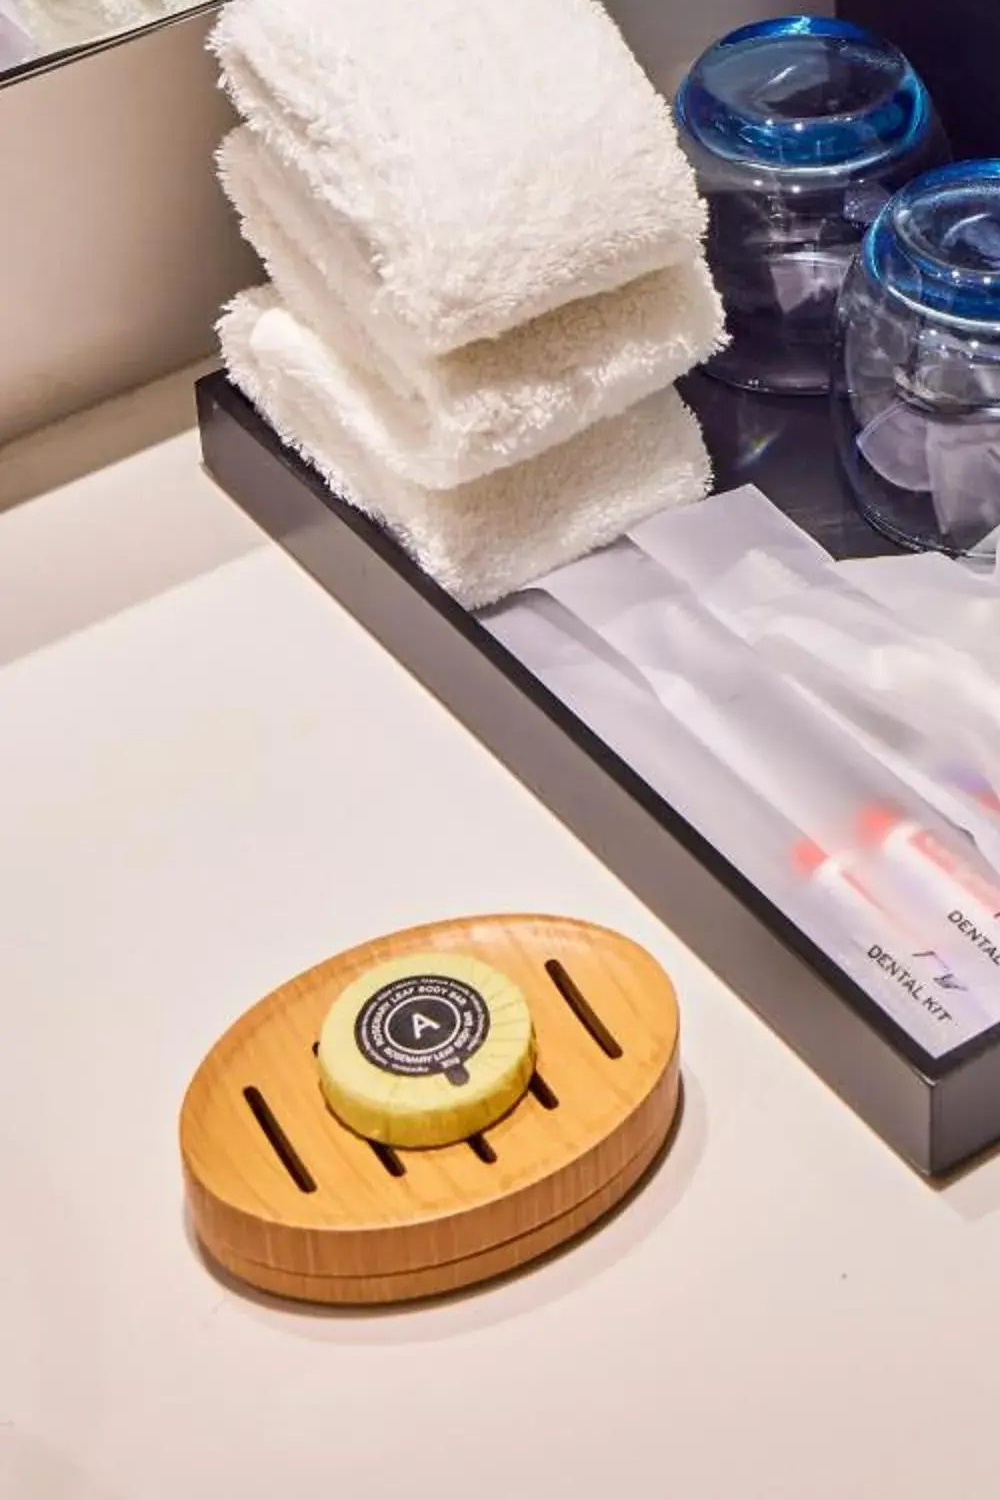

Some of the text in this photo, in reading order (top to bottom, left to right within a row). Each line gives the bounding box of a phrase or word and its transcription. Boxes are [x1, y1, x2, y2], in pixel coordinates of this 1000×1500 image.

[867, 944, 953, 1021] DENTAL KIT
[412, 1012, 441, 1040] A
